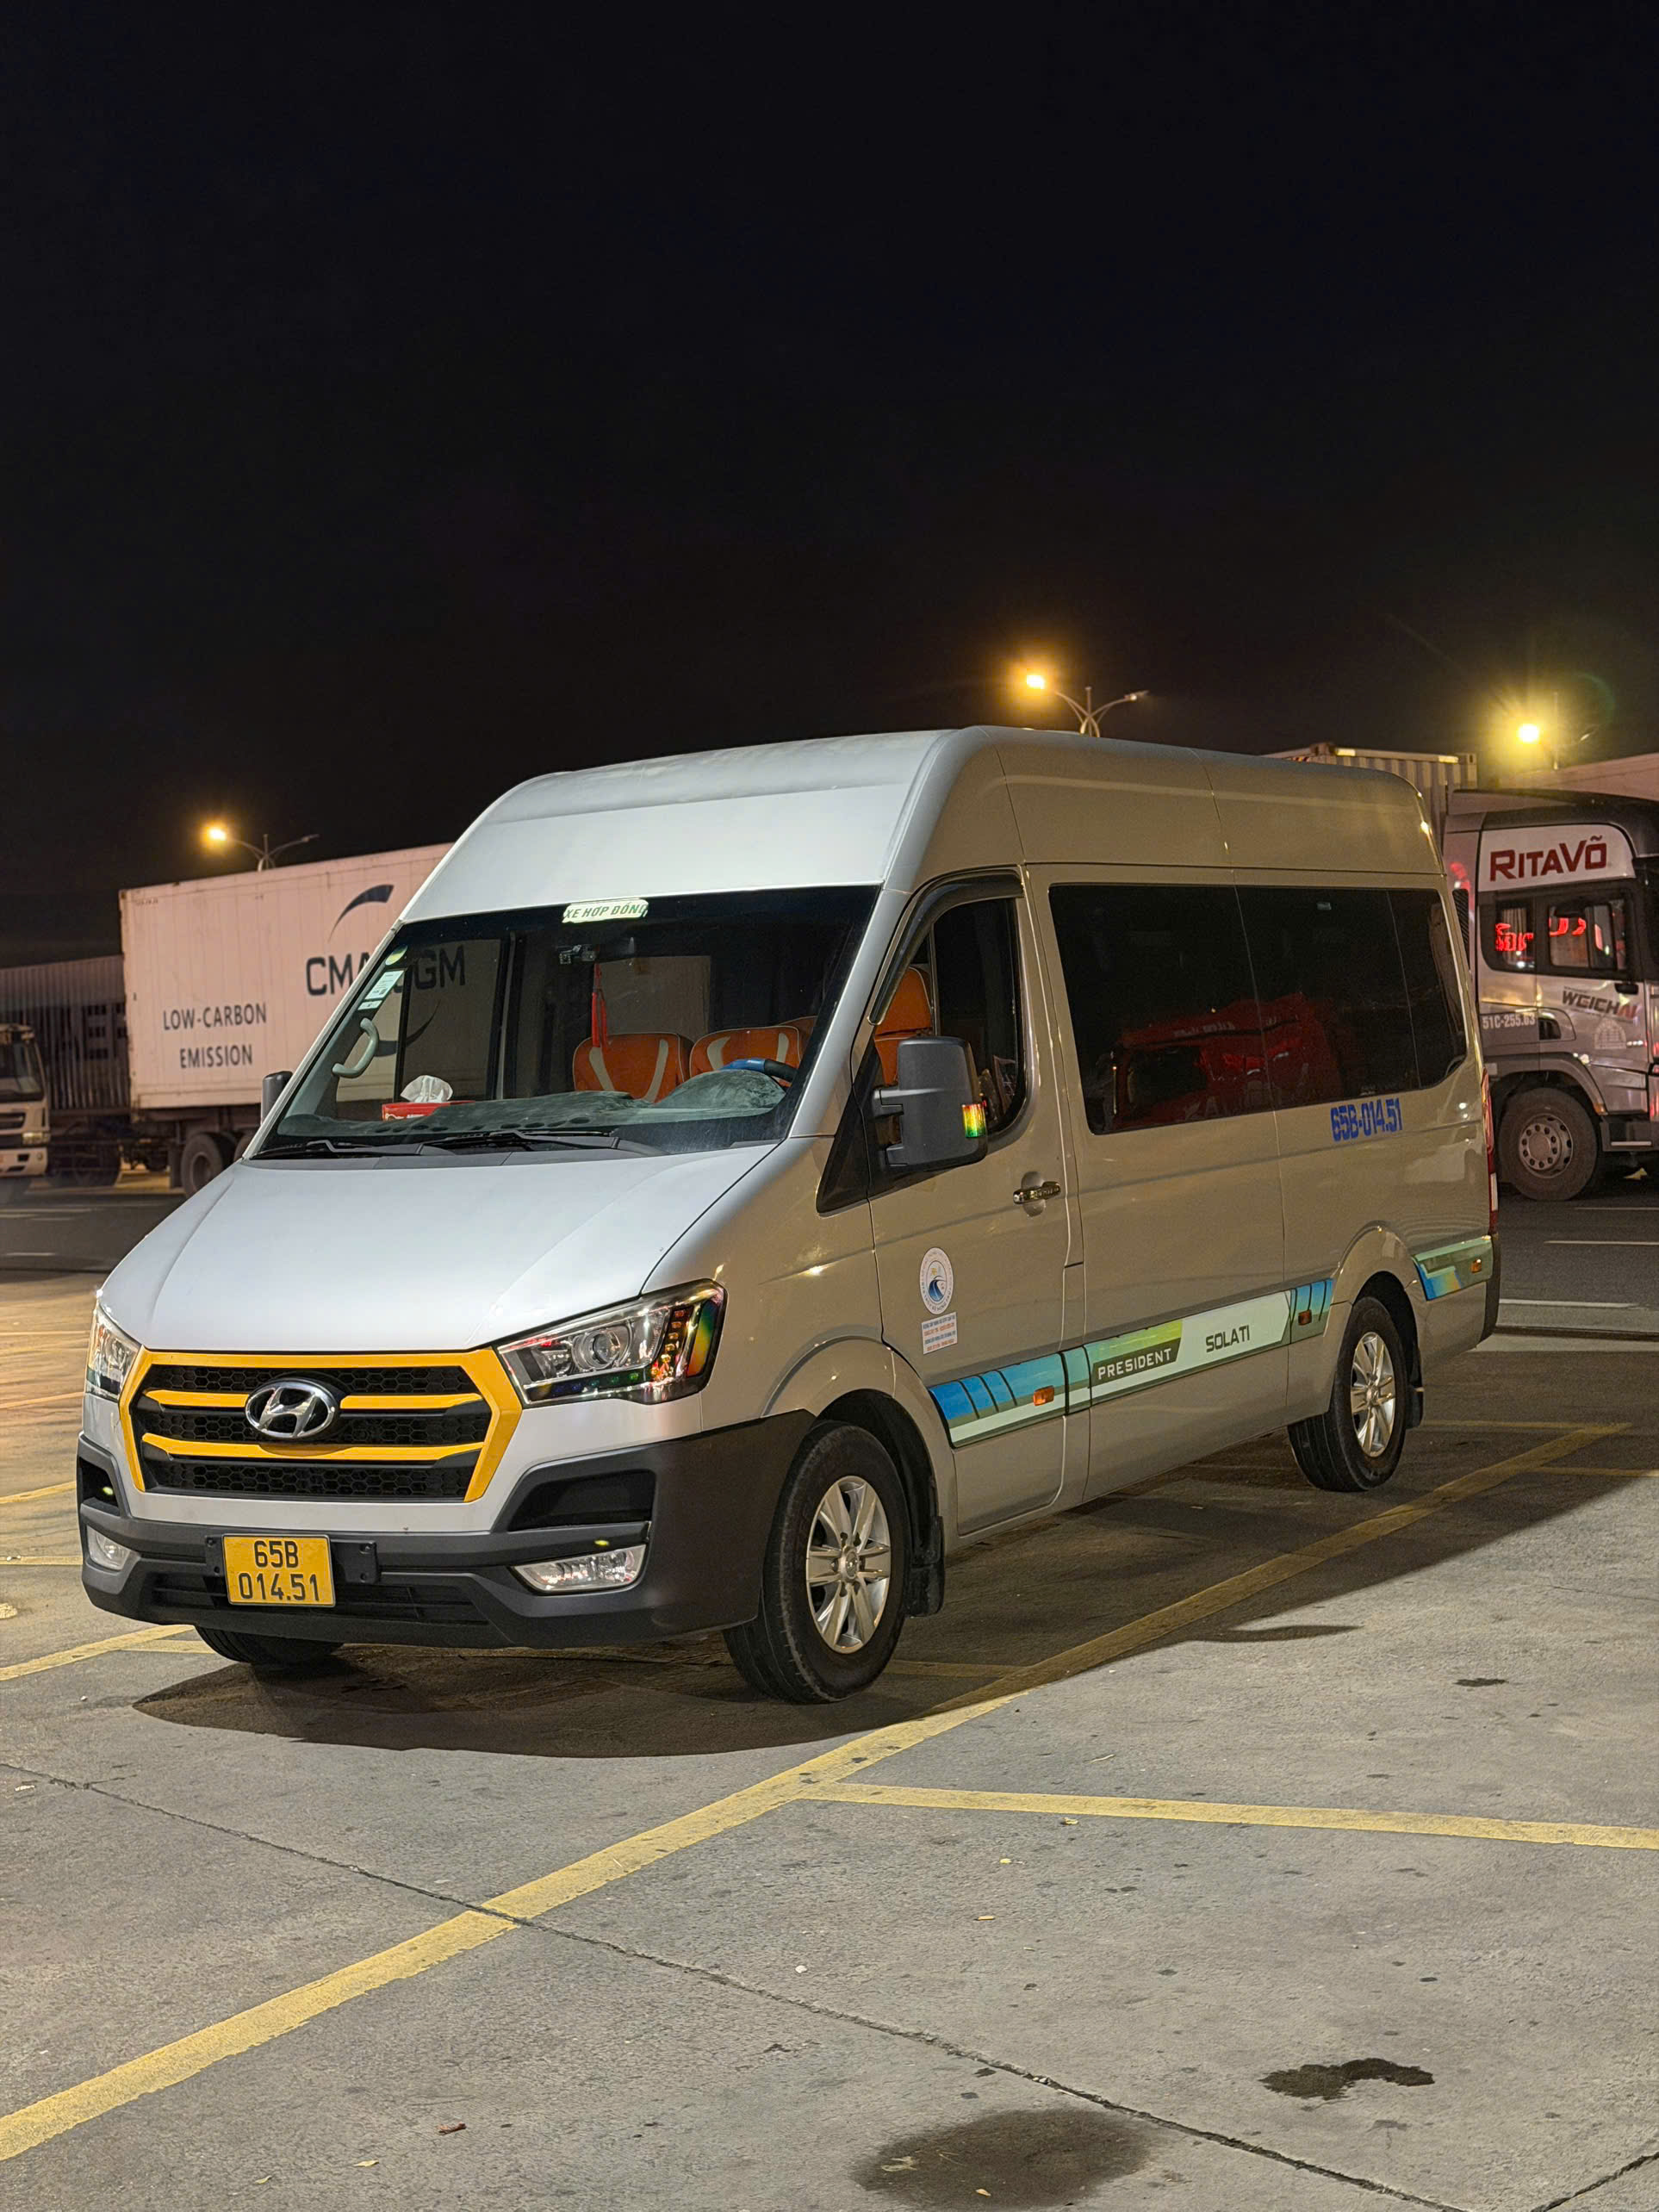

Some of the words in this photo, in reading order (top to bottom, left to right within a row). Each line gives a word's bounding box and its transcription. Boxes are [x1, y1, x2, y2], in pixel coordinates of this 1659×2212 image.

[163, 1002, 266, 1031] LOW-CARBON
[179, 1044, 252, 1069] EMISSION
[1330, 1097, 1403, 1142] 65B-014.51
[1206, 1325, 1250, 1353] SOLATI
[1097, 1348, 1171, 1380] PRESIDENT
[253, 1539, 299, 1569] 65B
[238, 1572, 320, 1601] 014.51
